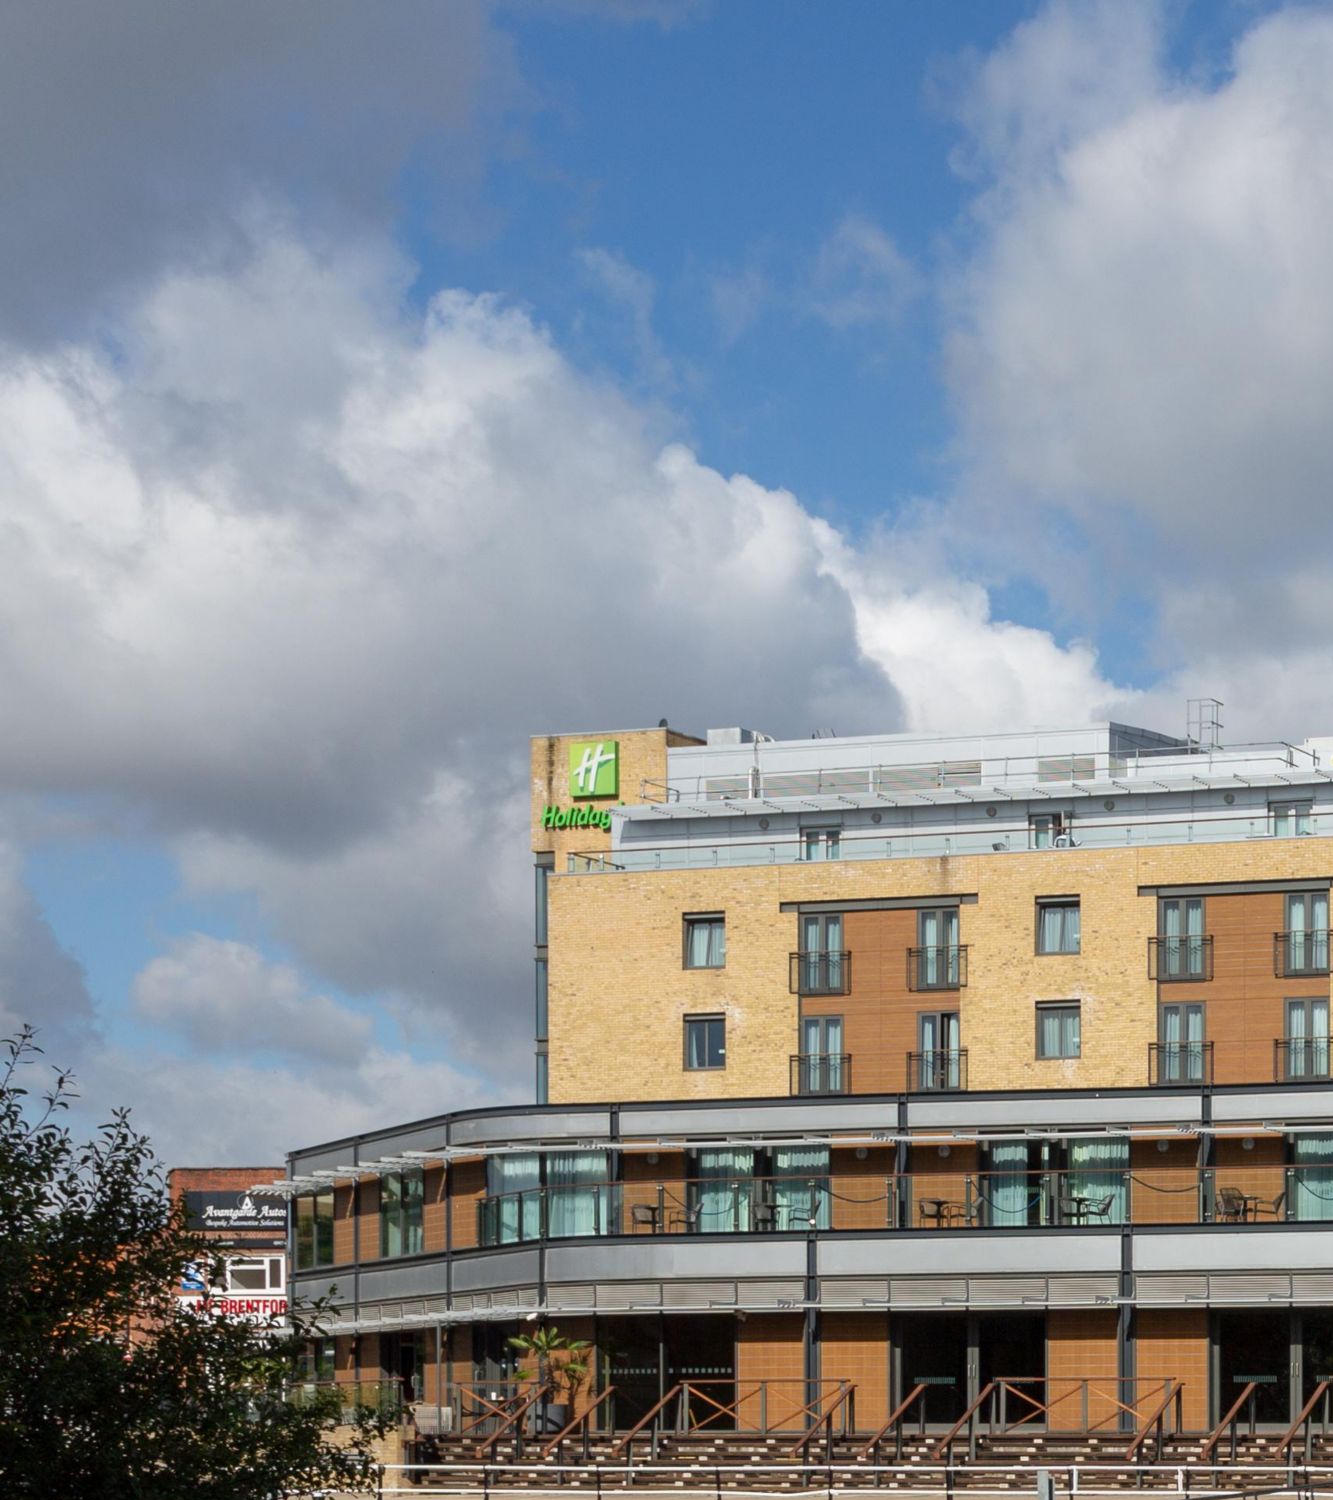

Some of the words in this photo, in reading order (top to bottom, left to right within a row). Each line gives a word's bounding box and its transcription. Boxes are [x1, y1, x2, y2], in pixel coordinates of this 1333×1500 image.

[541, 803, 611, 829] Holiday
[202, 1205, 257, 1220] Avantgarde
[259, 1219, 284, 1227] Solutions
